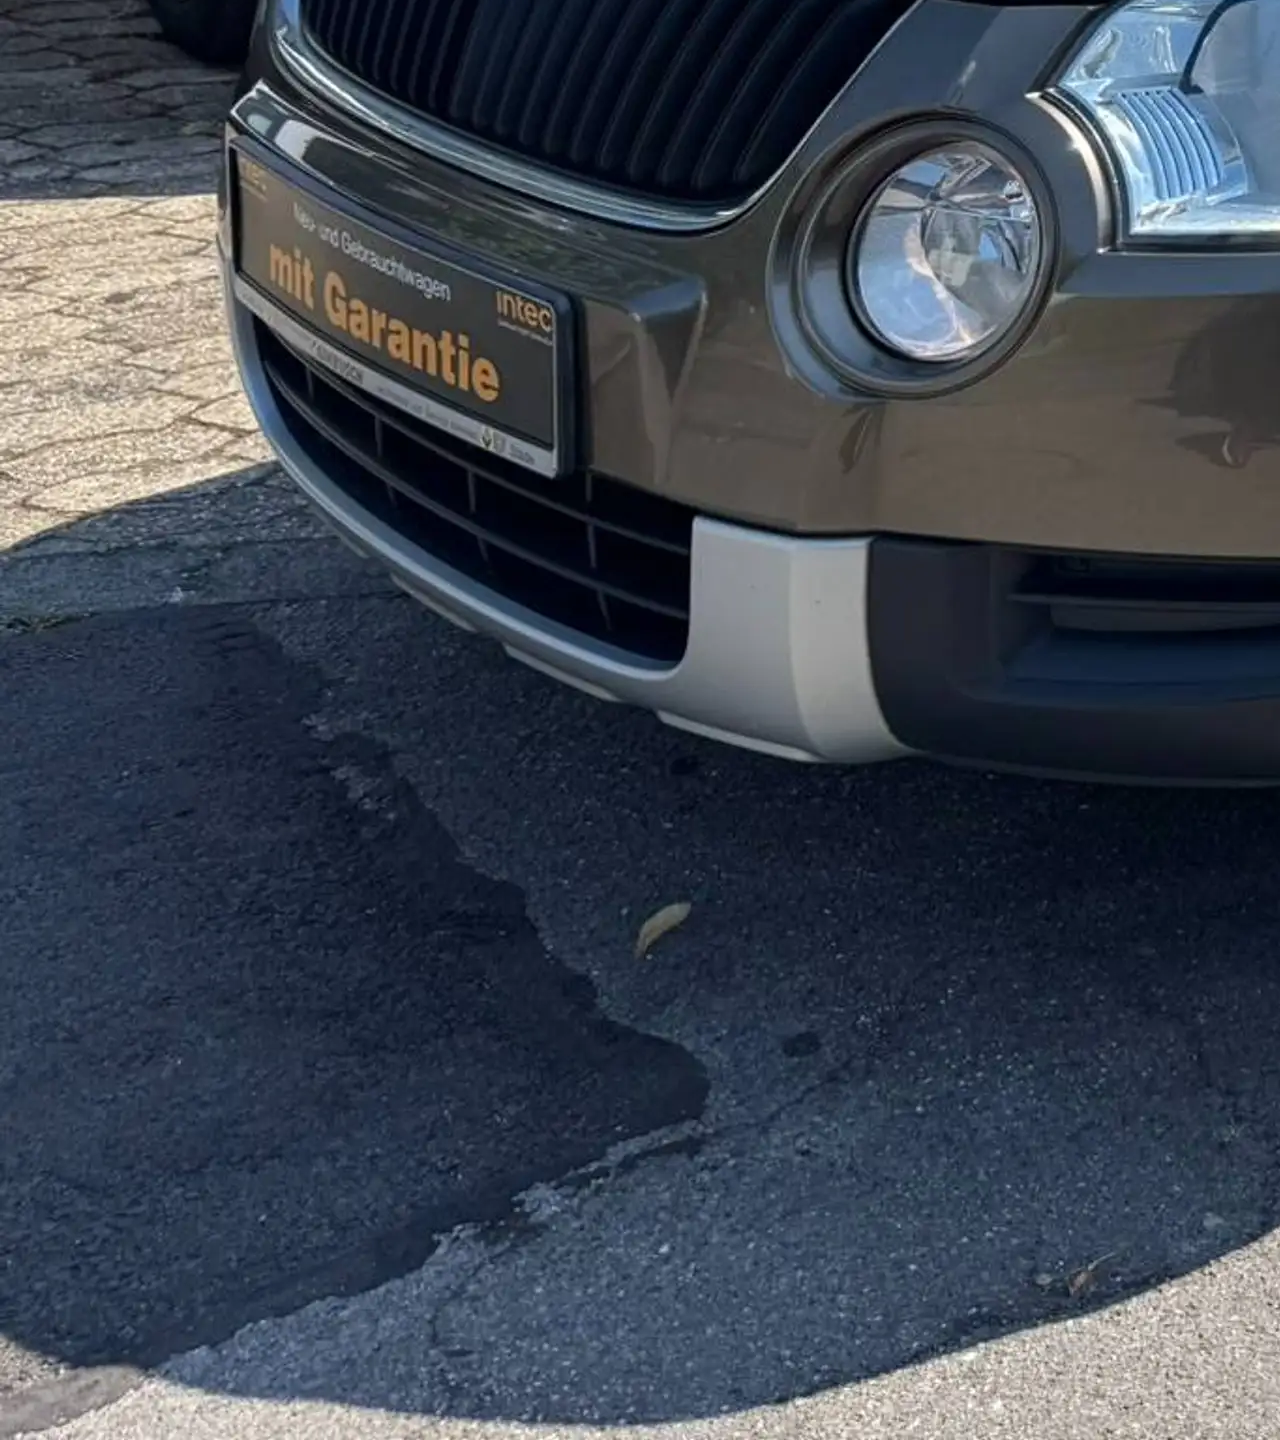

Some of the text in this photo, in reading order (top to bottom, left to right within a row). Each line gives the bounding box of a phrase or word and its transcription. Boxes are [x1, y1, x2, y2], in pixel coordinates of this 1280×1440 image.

[269, 244, 315, 311] mit
[323, 270, 501, 403] Garantie
[341, 231, 452, 302] Gebrauchtwagen
